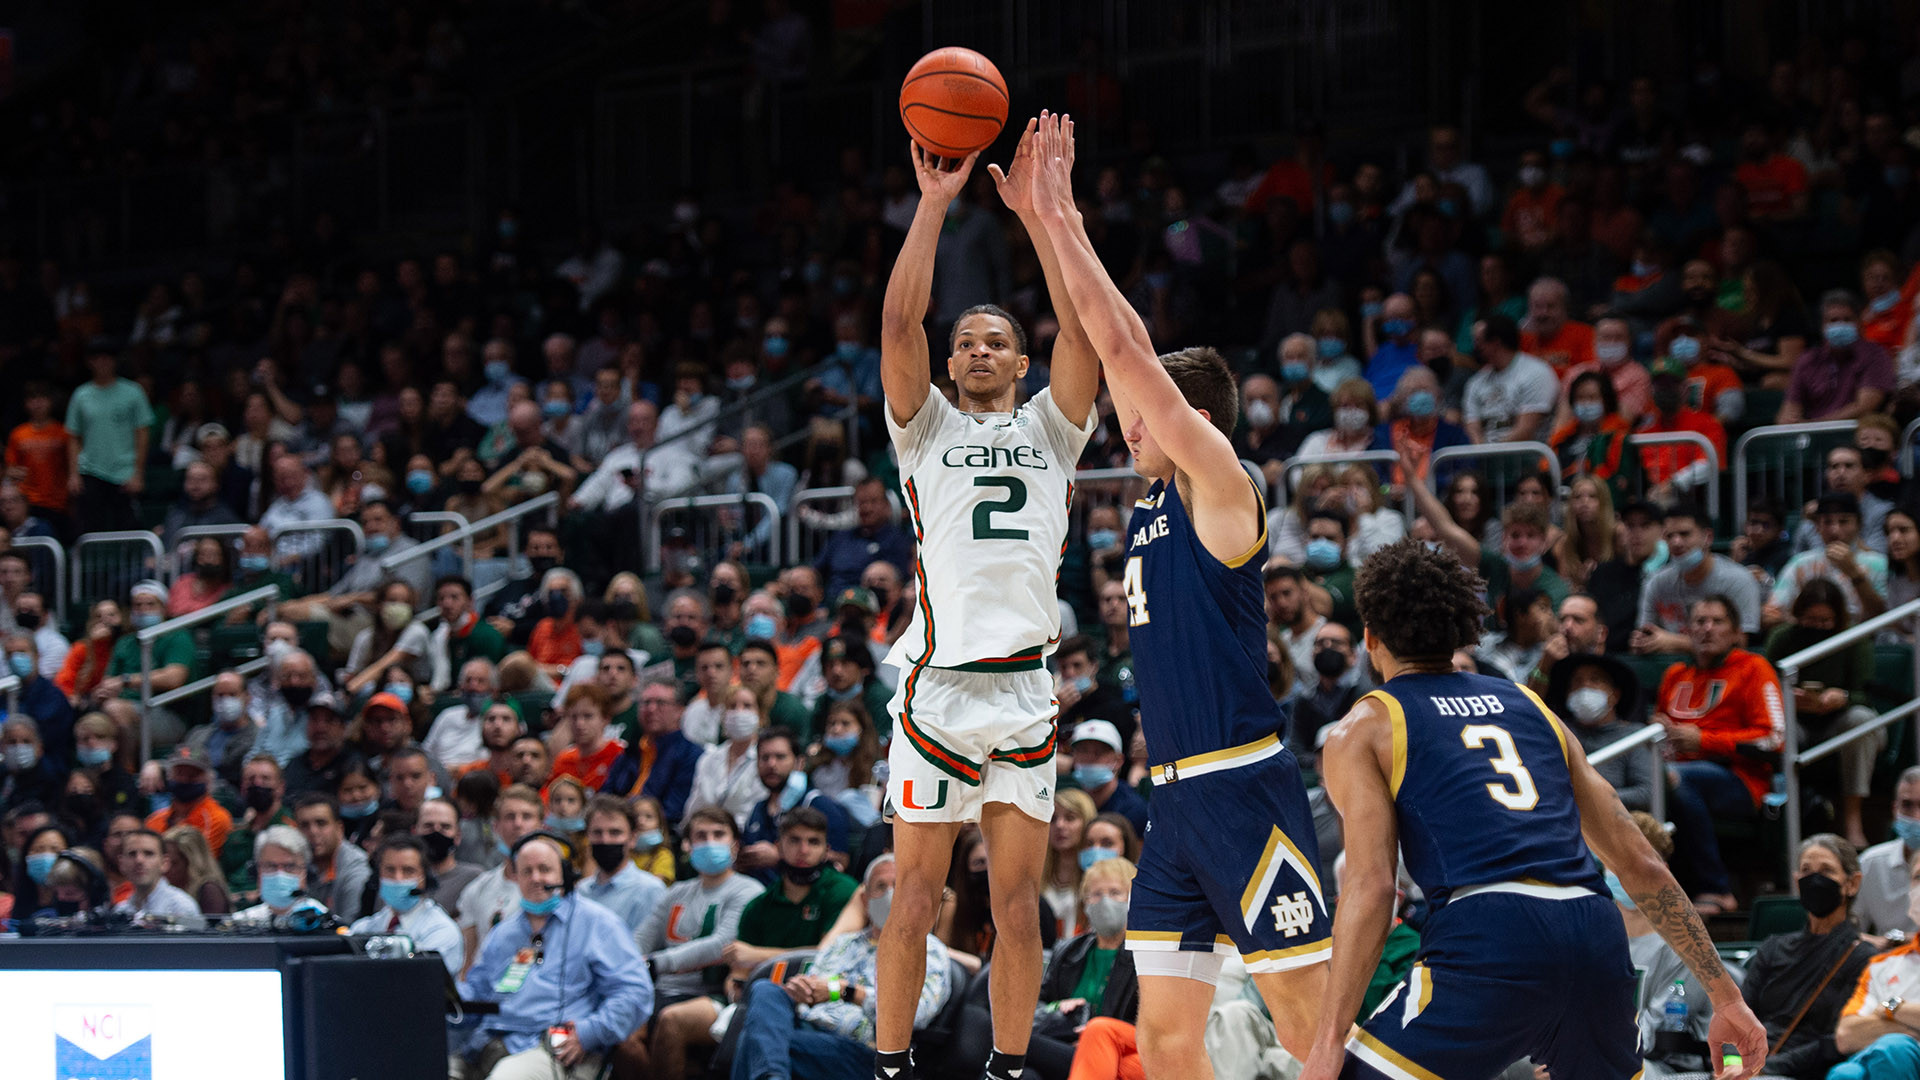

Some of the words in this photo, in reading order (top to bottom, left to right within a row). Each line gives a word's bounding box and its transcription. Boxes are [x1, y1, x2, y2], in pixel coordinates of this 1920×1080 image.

[972, 476, 1029, 540] 2
[1430, 694, 1505, 717] HUBB
[1460, 724, 1540, 811] 3
[902, 780, 949, 810] U
[82, 1014, 122, 1039] NCI
